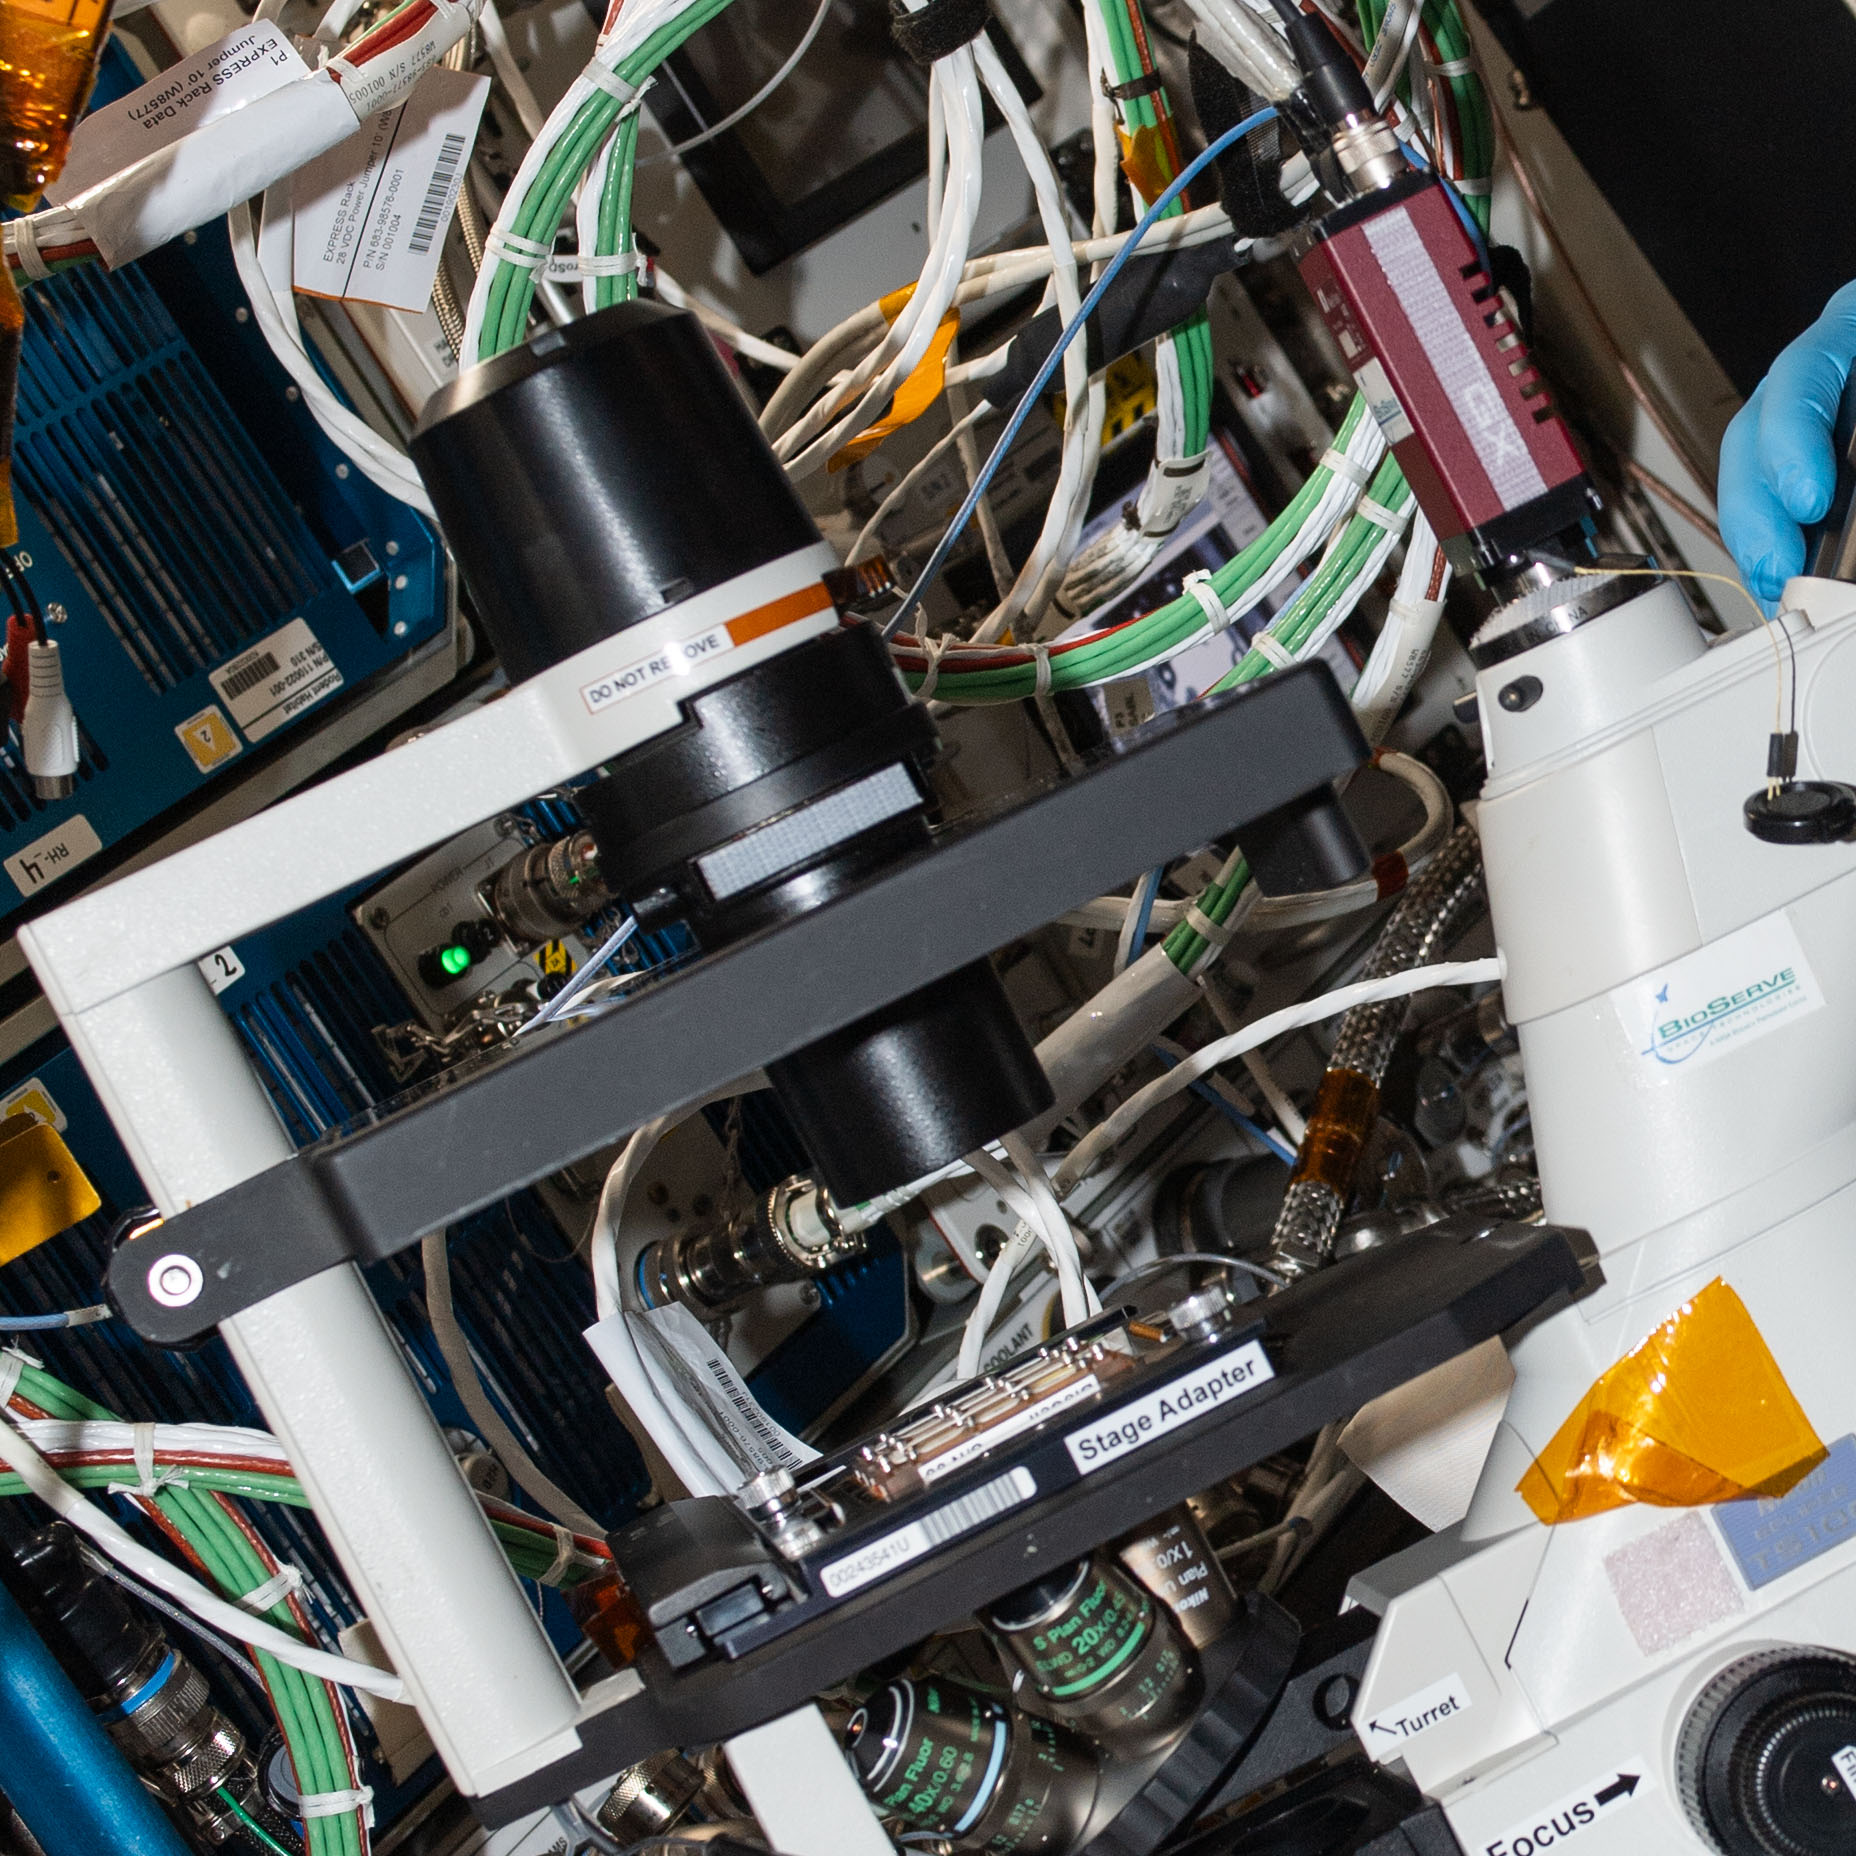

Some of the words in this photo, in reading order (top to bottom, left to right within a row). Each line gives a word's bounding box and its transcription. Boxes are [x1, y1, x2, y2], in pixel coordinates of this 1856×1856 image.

[204, 33, 257, 71] Jumper
[211, 39, 277, 85] EXPRESS
[270, 50, 287, 66] P1
[387, 61, 405, 78] S/N
[128, 81, 183, 120] (W8577)
[176, 82, 212, 107] Rack
[345, 76, 385, 103] 001005
[143, 106, 176, 129] Data
[359, 149, 378, 189] Jumper
[323, 207, 348, 261] EXPRESS
[341, 179, 356, 207] Rack
[349, 191, 367, 222] Power
[363, 247, 376, 268] P/N
[371, 167, 405, 248] 683-98576-0001
[341, 224, 356, 249] VDC
[381, 212, 403, 250] 001004
[335, 250, 349, 265] 28
[376, 251, 390, 271] S/N
[303, 639, 323, 657] S/N
[310, 651, 330, 668] P/N
[309, 670, 338, 697] Rodent
[589, 683, 615, 704] DO
[614, 669, 648, 693] NOT
[650, 636, 717, 673] REOVE
[281, 690, 313, 716] Habitat
[1079, 1416, 1151, 1459] Stage
[1160, 1361, 1253, 1420] Adapter
[1175, 1560, 1209, 1588] Plan
[1032, 1635, 1049, 1653] S
[1046, 1613, 1084, 1645] Plan
[1080, 1577, 1110, 1619] Fluor
[1396, 1697, 1458, 1735] Turret
[904, 1736, 936, 1784] Fluor
